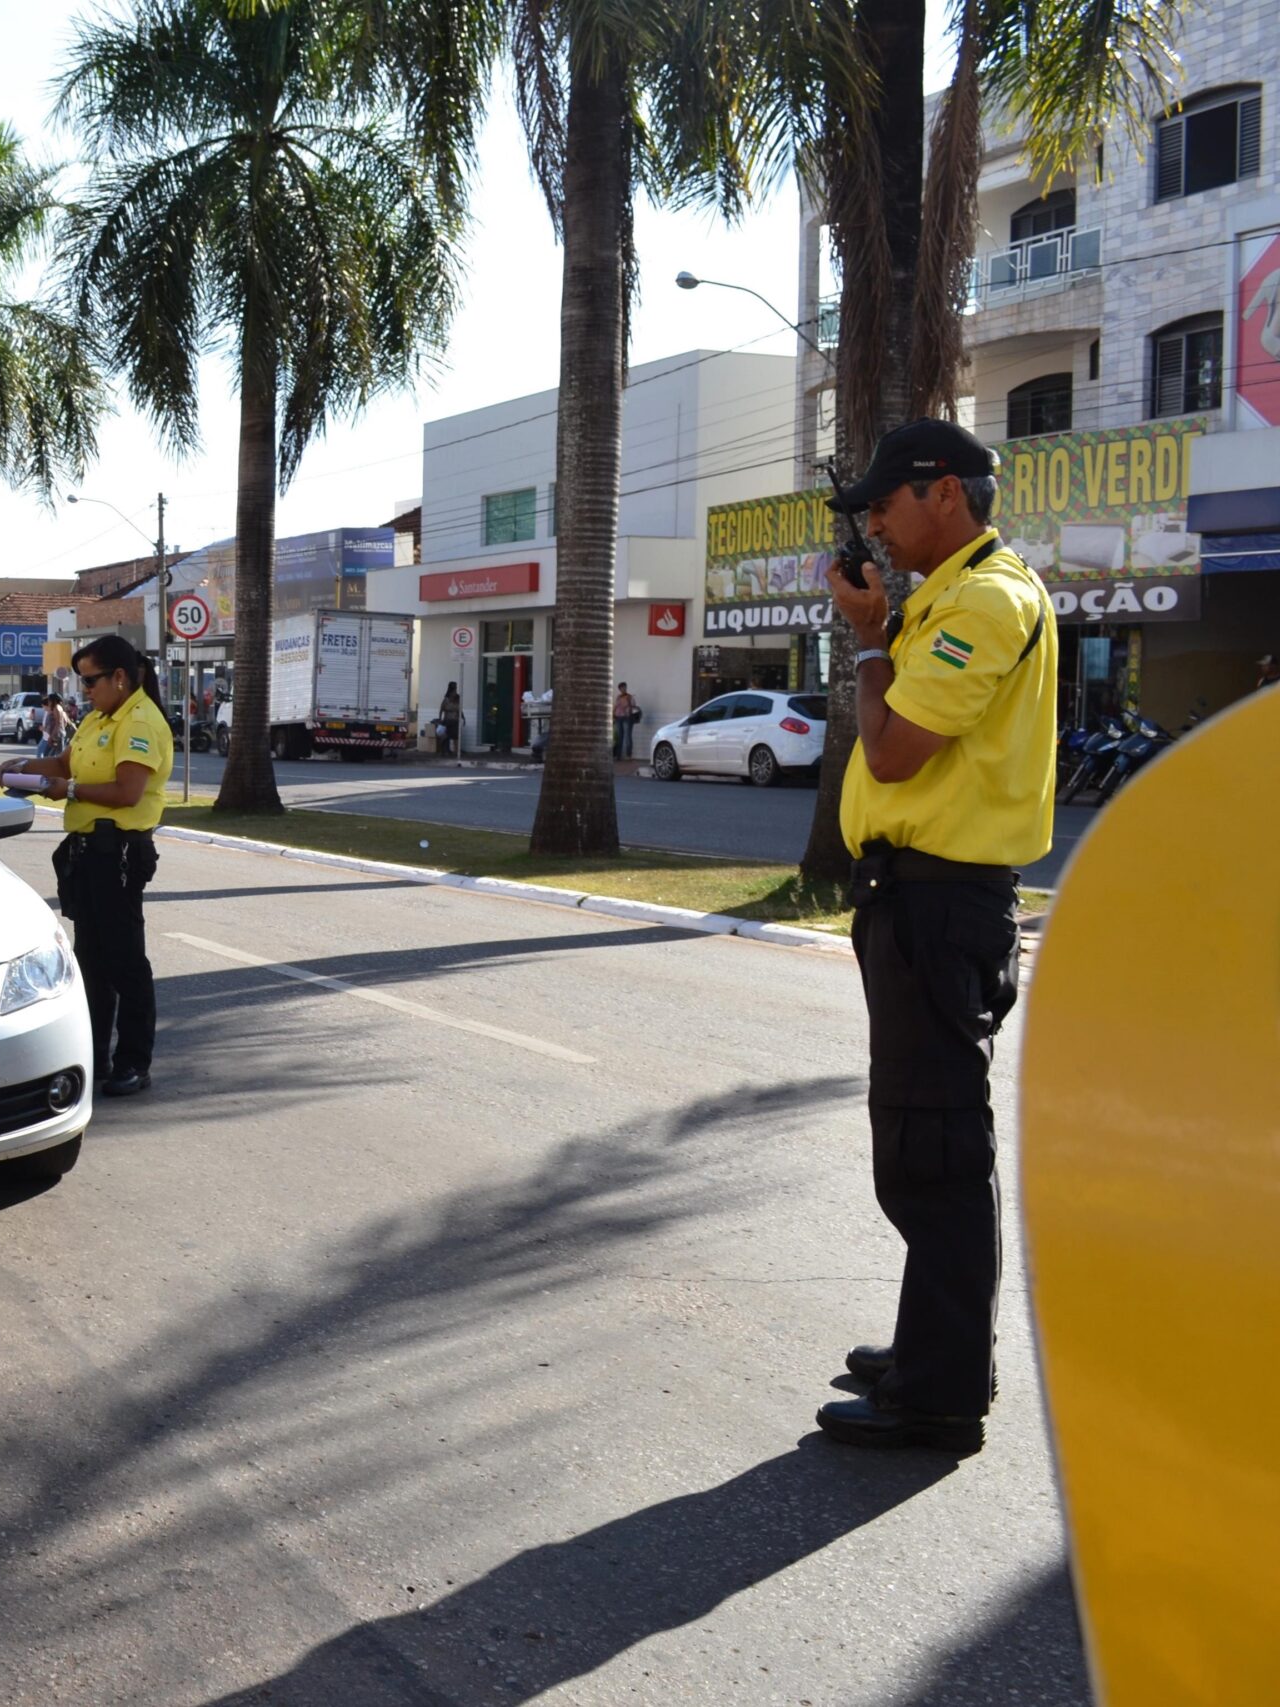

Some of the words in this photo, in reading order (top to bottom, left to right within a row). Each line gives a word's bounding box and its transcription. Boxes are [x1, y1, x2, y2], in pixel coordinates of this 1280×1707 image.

[1013, 446, 1071, 514] RIO
[709, 505, 773, 556] TECIDOS
[778, 499, 807, 548] RIO
[812, 495, 834, 544] VE
[459, 577, 497, 594] Santander
[1052, 583, 1179, 621] OÇÃO
[177, 606, 202, 625] 50
[706, 600, 833, 633] LIQUIDAÇ
[321, 633, 358, 648] FRETES
[459, 632, 468, 643] E
